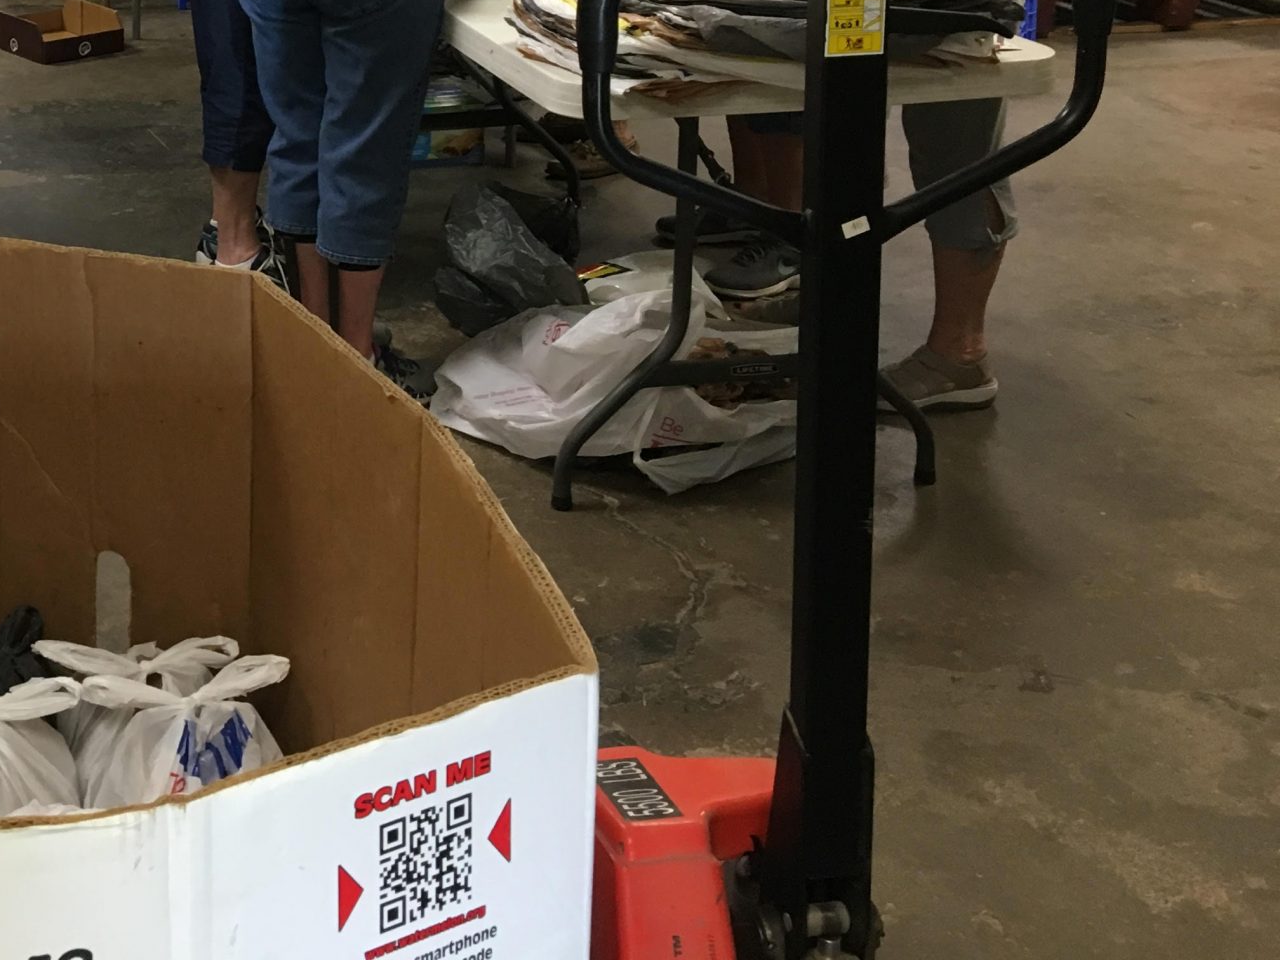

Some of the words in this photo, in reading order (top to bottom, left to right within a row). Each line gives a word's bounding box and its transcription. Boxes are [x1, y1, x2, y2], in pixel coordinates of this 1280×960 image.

[354, 769, 437, 819] SCAN
[446, 750, 492, 788] ME
[612, 788, 675, 817] 5500
[462, 947, 493, 960] ode
